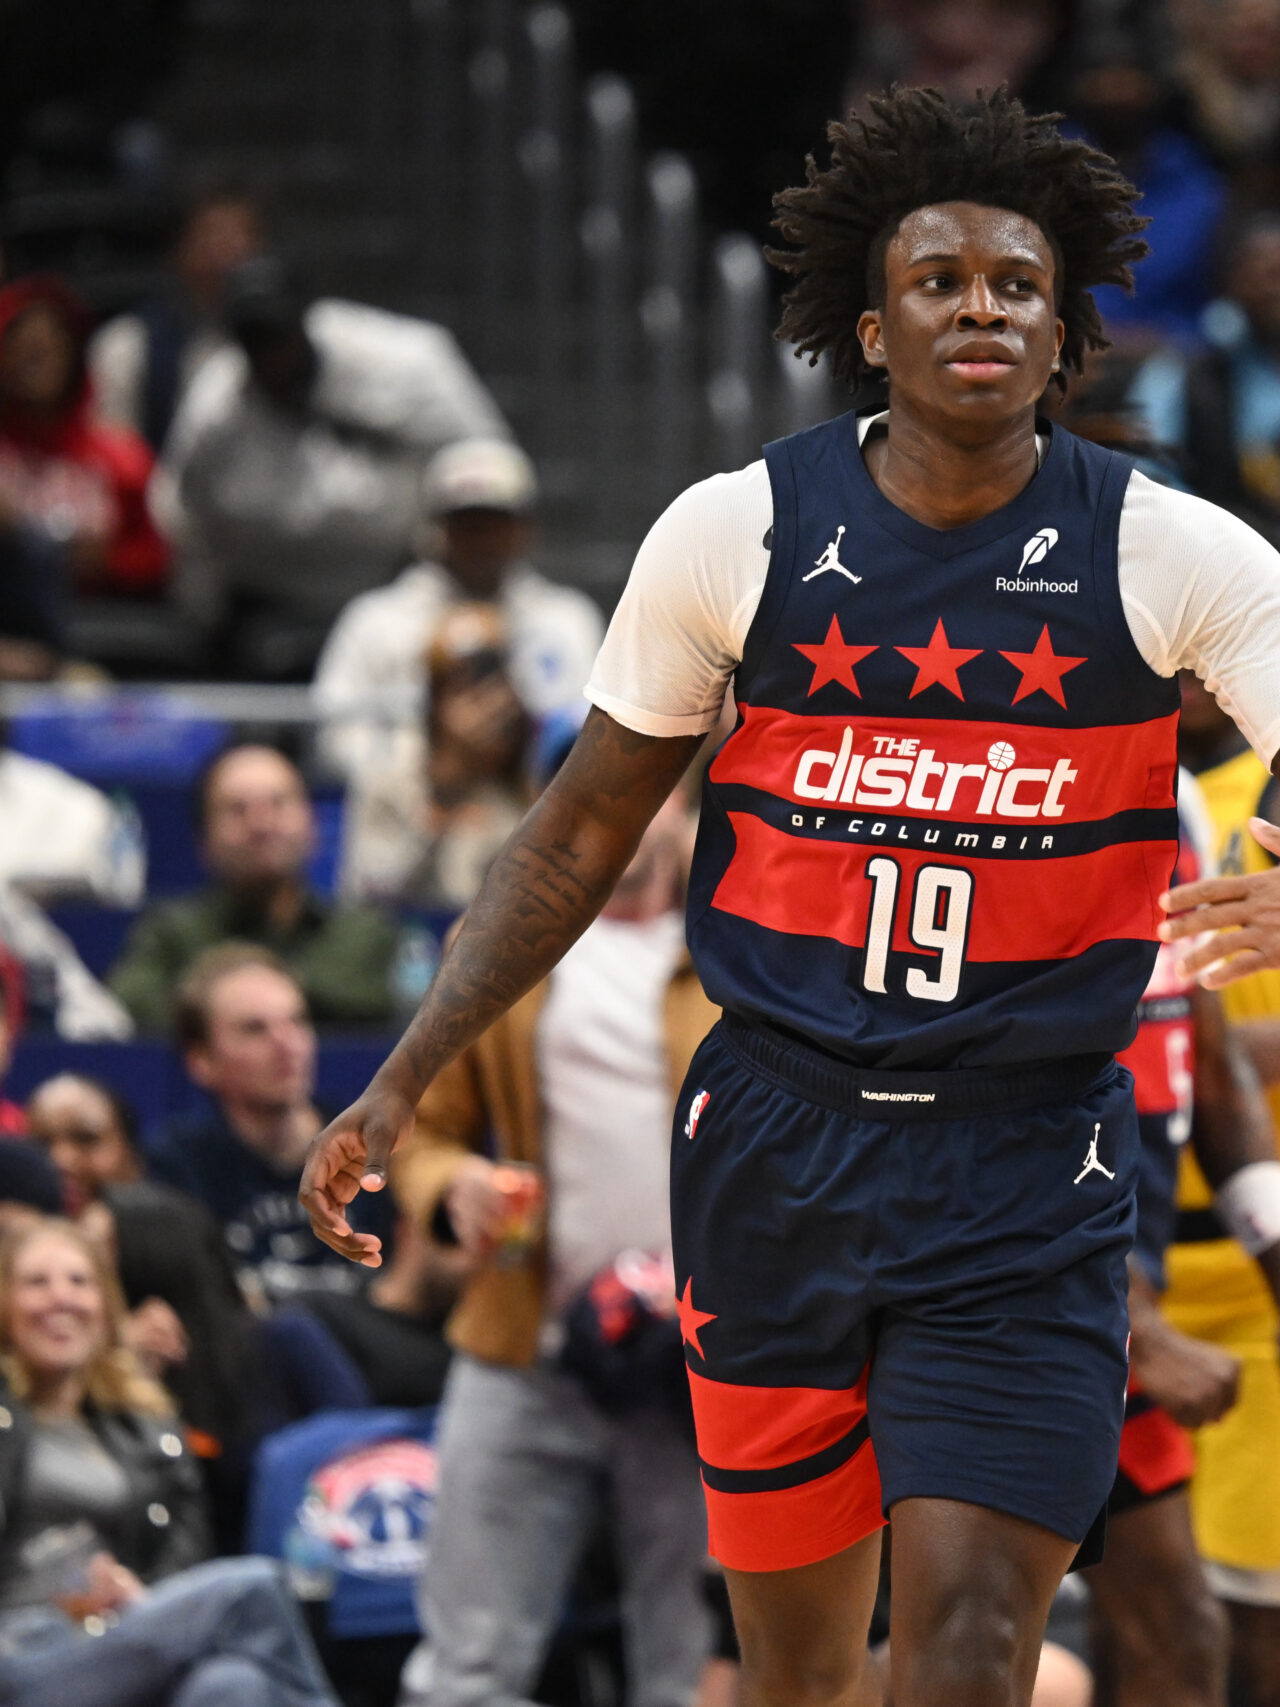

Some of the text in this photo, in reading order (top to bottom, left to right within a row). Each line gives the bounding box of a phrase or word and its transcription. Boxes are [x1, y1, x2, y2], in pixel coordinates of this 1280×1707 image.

[996, 577, 1078, 594] Robinhood
[872, 736, 921, 757] THE
[793, 725, 1079, 818] district
[791, 814, 1054, 851] OF COLUMBIA
[863, 856, 973, 1003] 19
[861, 1089, 936, 1102] WASHINGTON
